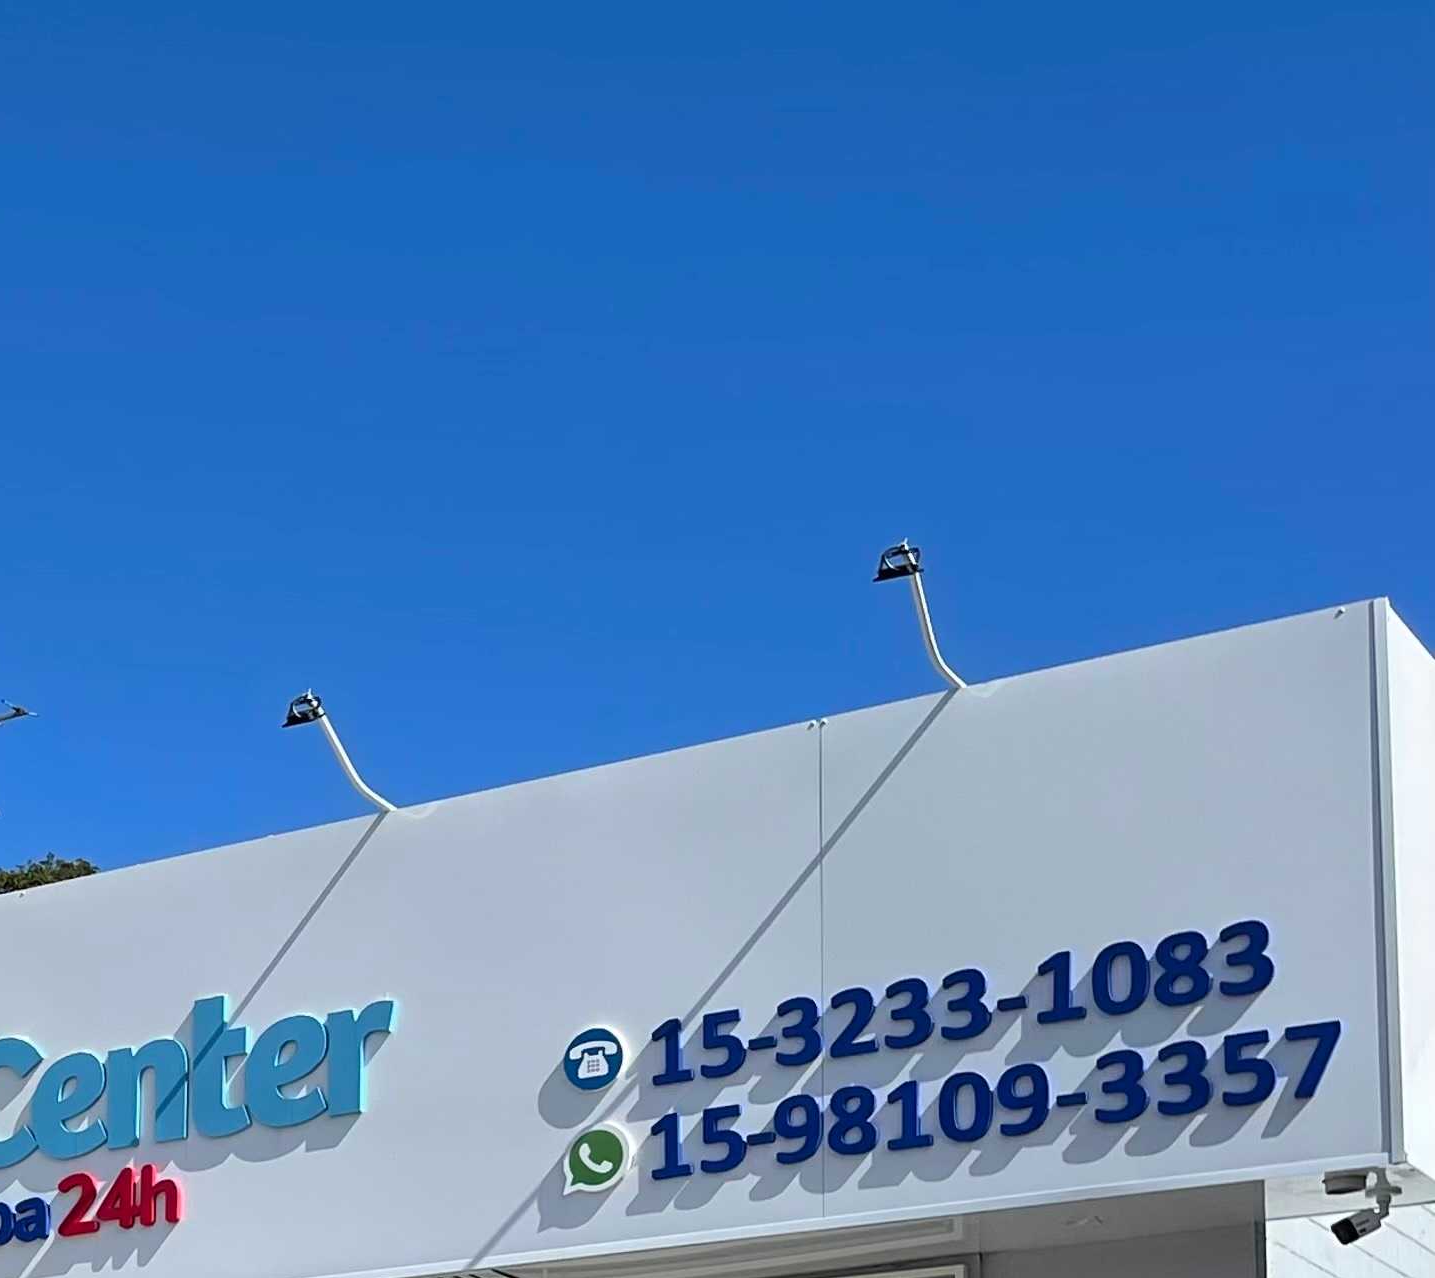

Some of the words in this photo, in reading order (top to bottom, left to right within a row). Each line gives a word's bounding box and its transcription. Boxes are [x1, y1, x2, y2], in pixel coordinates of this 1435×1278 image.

[650, 919, 1275, 1087] 15-3233-1083
[650, 1019, 1342, 1182] 15-98109-3357
[57, 1163, 181, 1238] 24h
